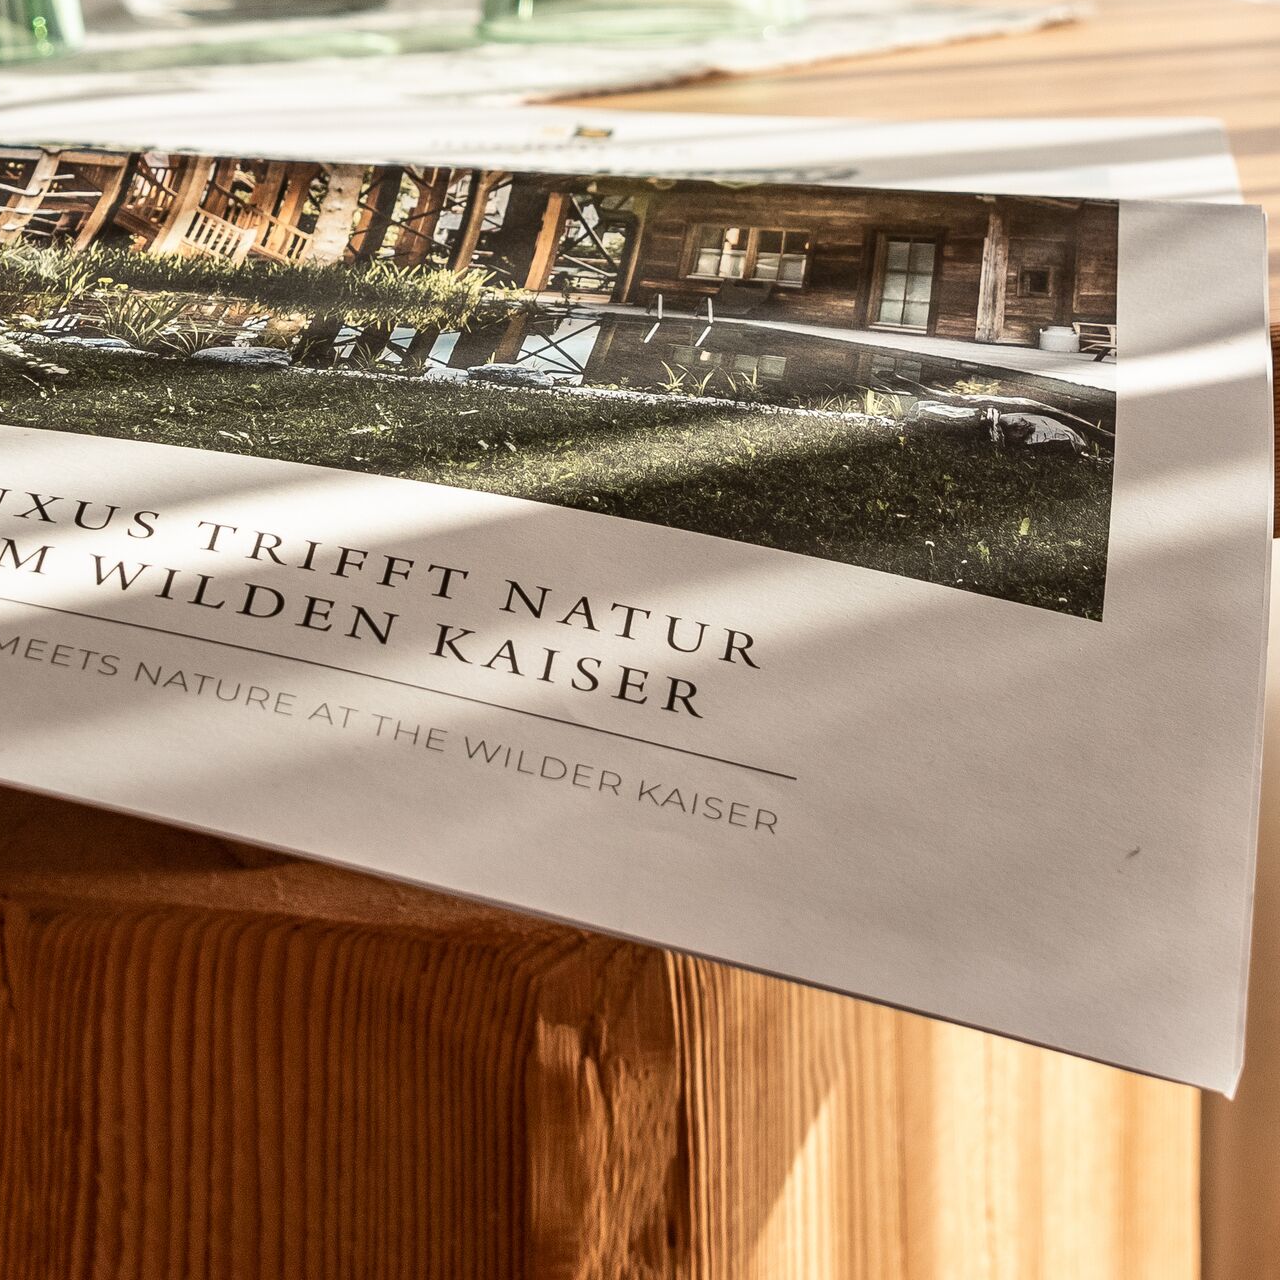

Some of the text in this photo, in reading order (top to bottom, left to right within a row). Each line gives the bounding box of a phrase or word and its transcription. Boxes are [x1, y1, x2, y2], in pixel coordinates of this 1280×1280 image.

[90, 553, 401, 646] WILDEN
[428, 622, 704, 720] KAISER
[198, 520, 469, 600] TRIFFT
[498, 578, 761, 670] NATUR
[133, 661, 296, 717] NATURE
[308, 701, 358, 728] AT
[371, 713, 448, 754] THE
[463, 735, 624, 797] WILDER
[637, 779, 779, 836] KAISER
